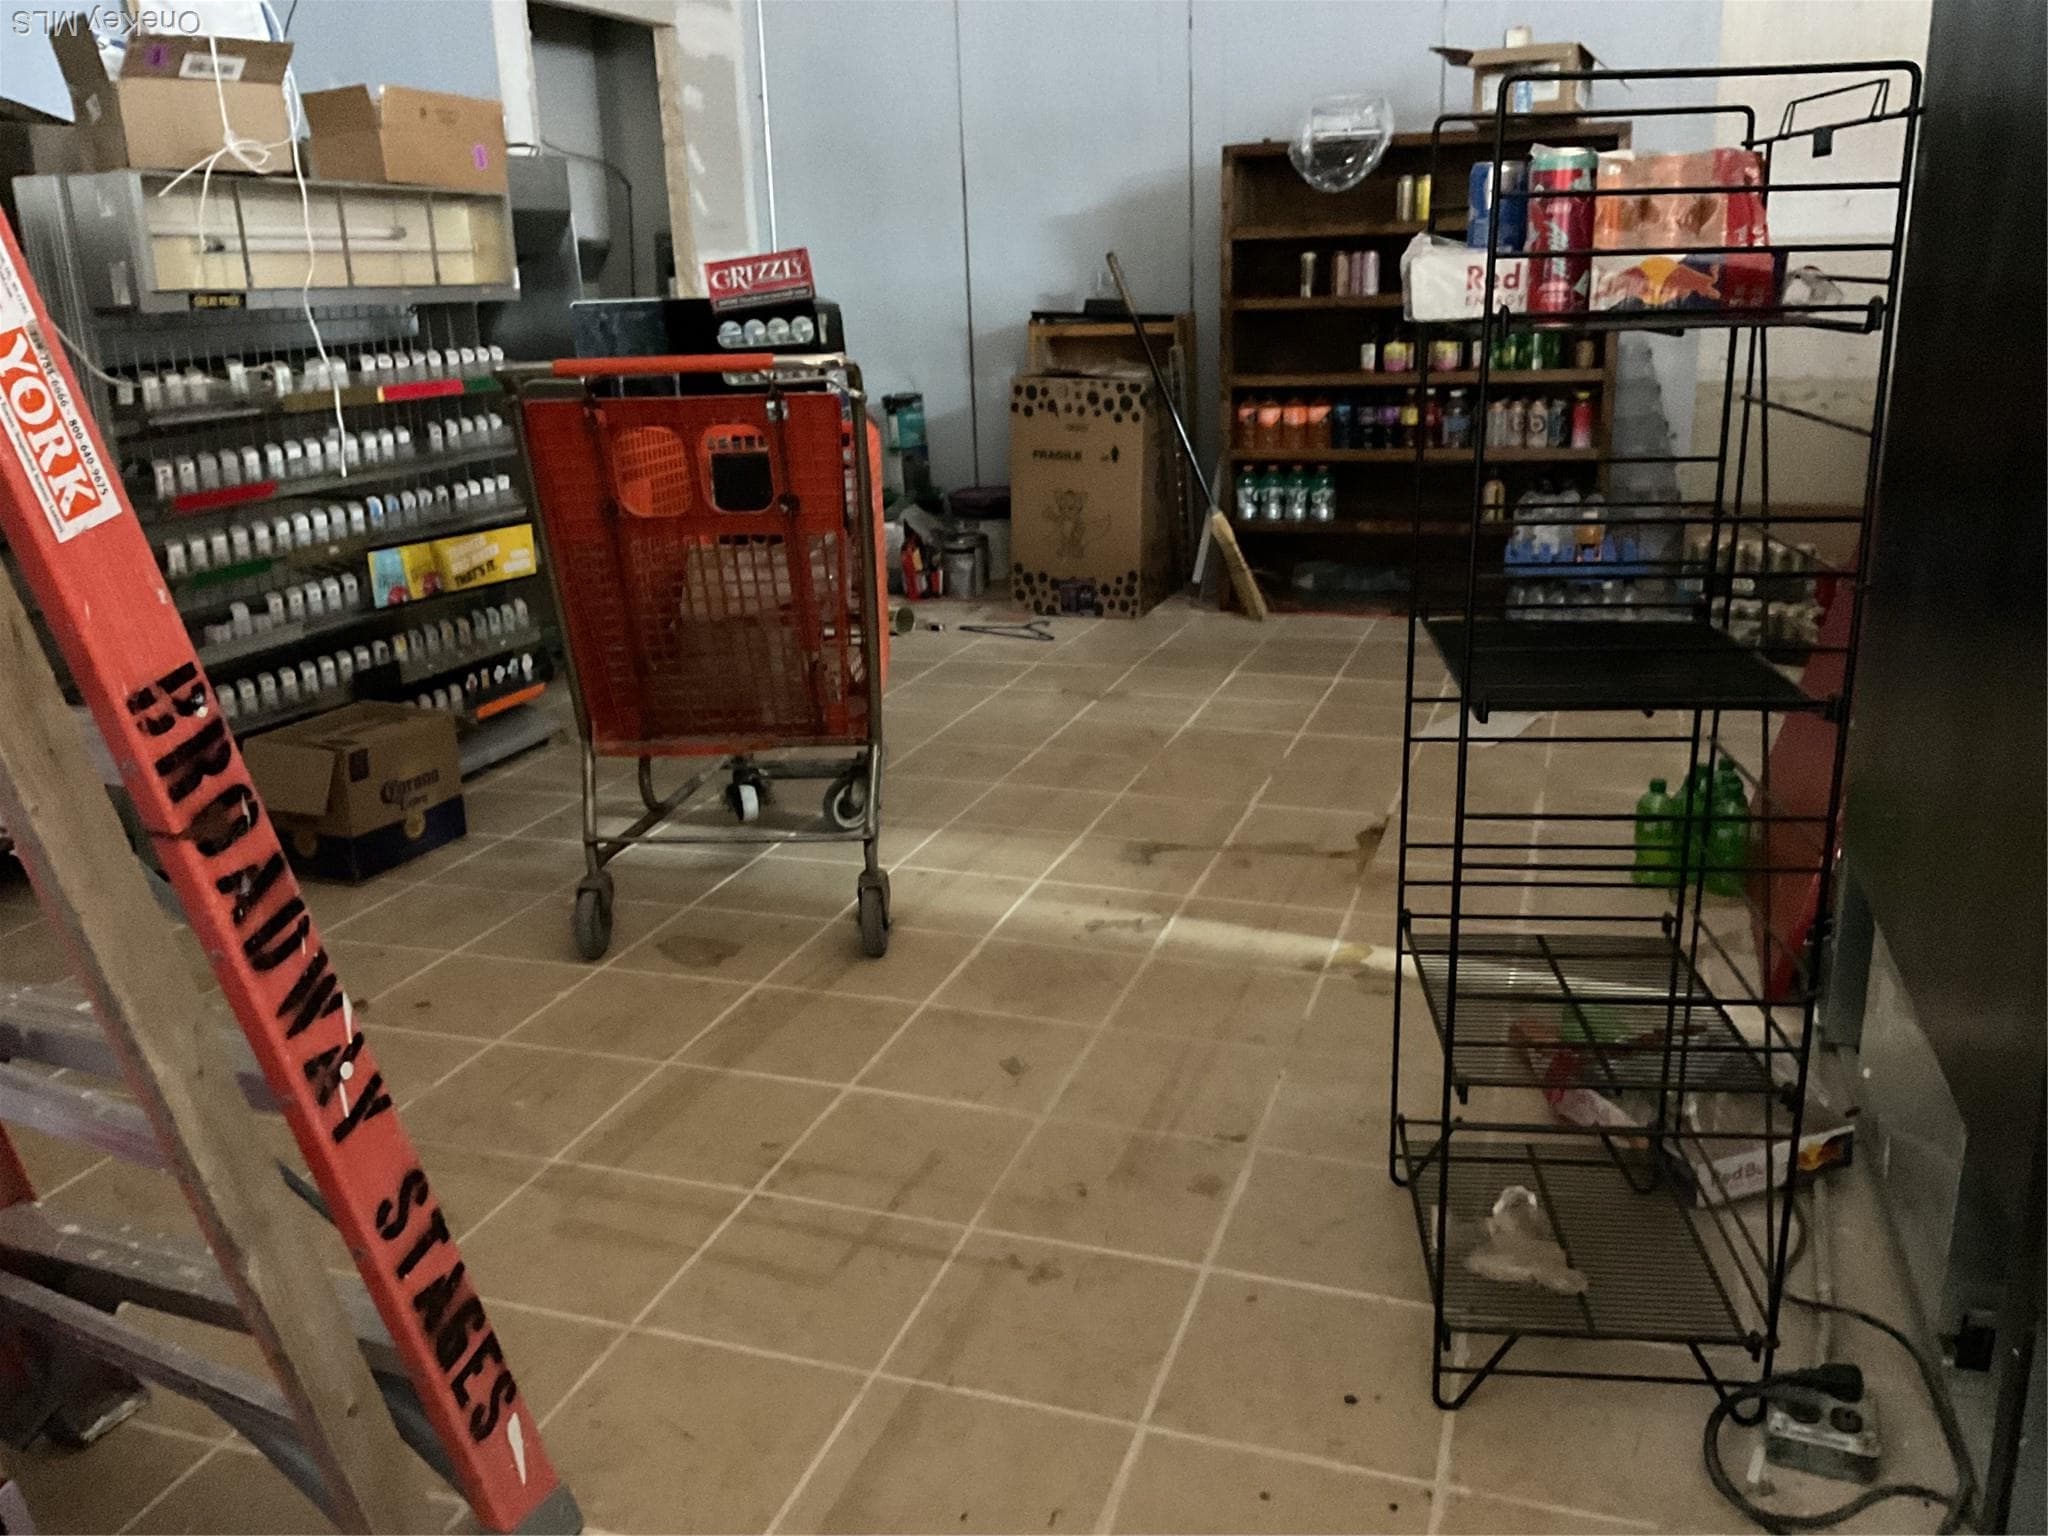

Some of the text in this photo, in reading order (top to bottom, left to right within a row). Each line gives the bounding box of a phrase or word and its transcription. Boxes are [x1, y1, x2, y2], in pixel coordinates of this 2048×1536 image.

[711, 256, 806, 290] GRIZZLY
[0, 332, 97, 517] YORK
[69, 418, 109, 496] 800-640-9675
[126, 661, 517, 1443] BROADWAY STAGES
